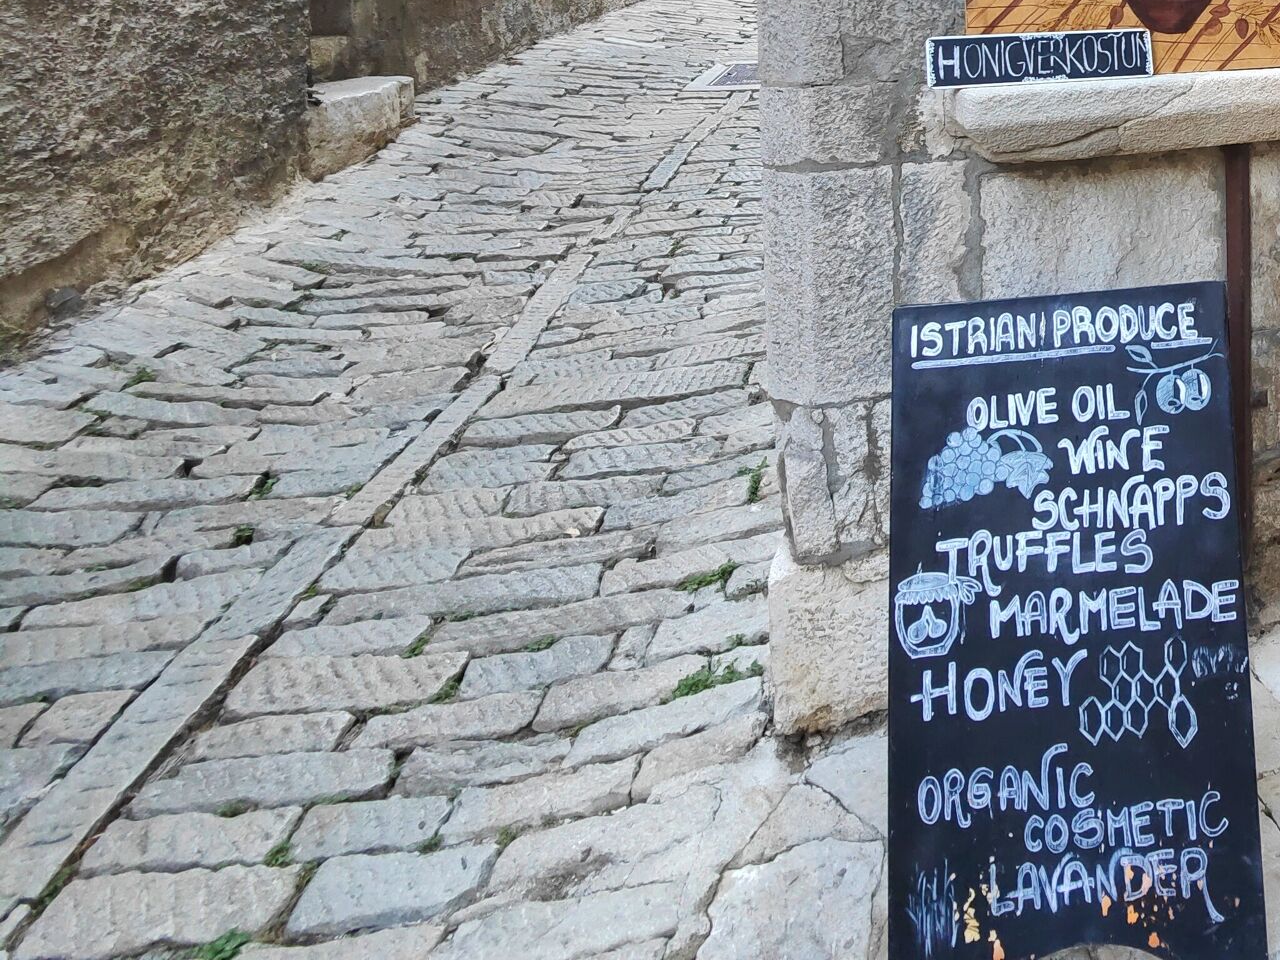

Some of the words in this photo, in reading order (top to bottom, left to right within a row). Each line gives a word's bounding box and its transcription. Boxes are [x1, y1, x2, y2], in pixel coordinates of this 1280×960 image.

[911, 312, 1037, 357] ISTRIAN
[1053, 302, 1199, 347] PRODUCE
[966, 387, 1059, 430] OLIVE
[1071, 384, 1130, 422] OIL
[1058, 425, 1170, 474] WINE
[1032, 472, 1231, 531] SCHNAPPS
[935, 530, 1154, 596] TRUFFLES
[990, 579, 1240, 645] MARMELADE
[910, 648, 1088, 722] HONEY
[917, 743, 1096, 828] ORGANIC
[1024, 791, 1229, 853] COSMETIC
[989, 847, 1225, 923] LAVANDER
